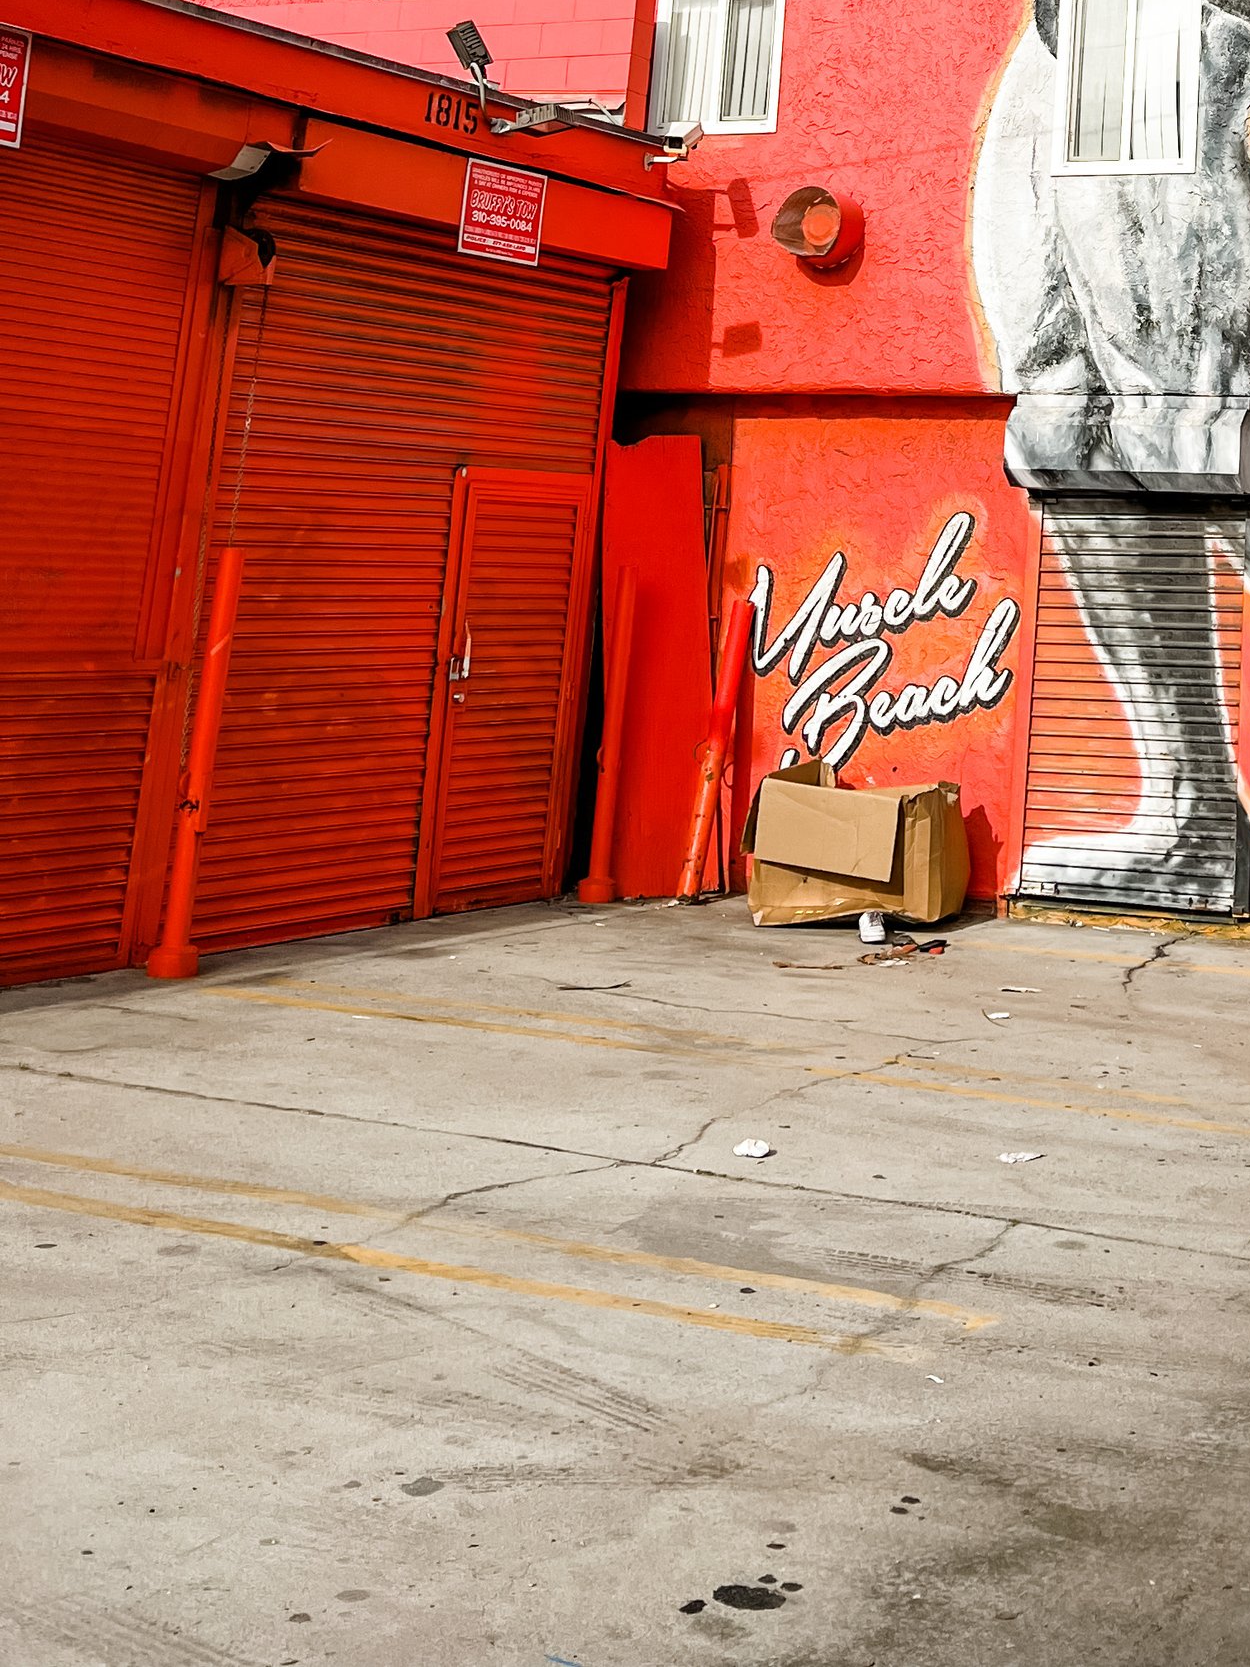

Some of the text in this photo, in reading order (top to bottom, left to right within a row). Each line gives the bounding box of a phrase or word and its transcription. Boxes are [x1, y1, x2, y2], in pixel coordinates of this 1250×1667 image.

[424, 91, 479, 135] 1815
[470, 189, 538, 220] BRUFFY'S TOW
[471, 210, 533, 233] 310-395-0084
[748, 511, 977, 686] Muscle
[782, 598, 1020, 774] Beach
